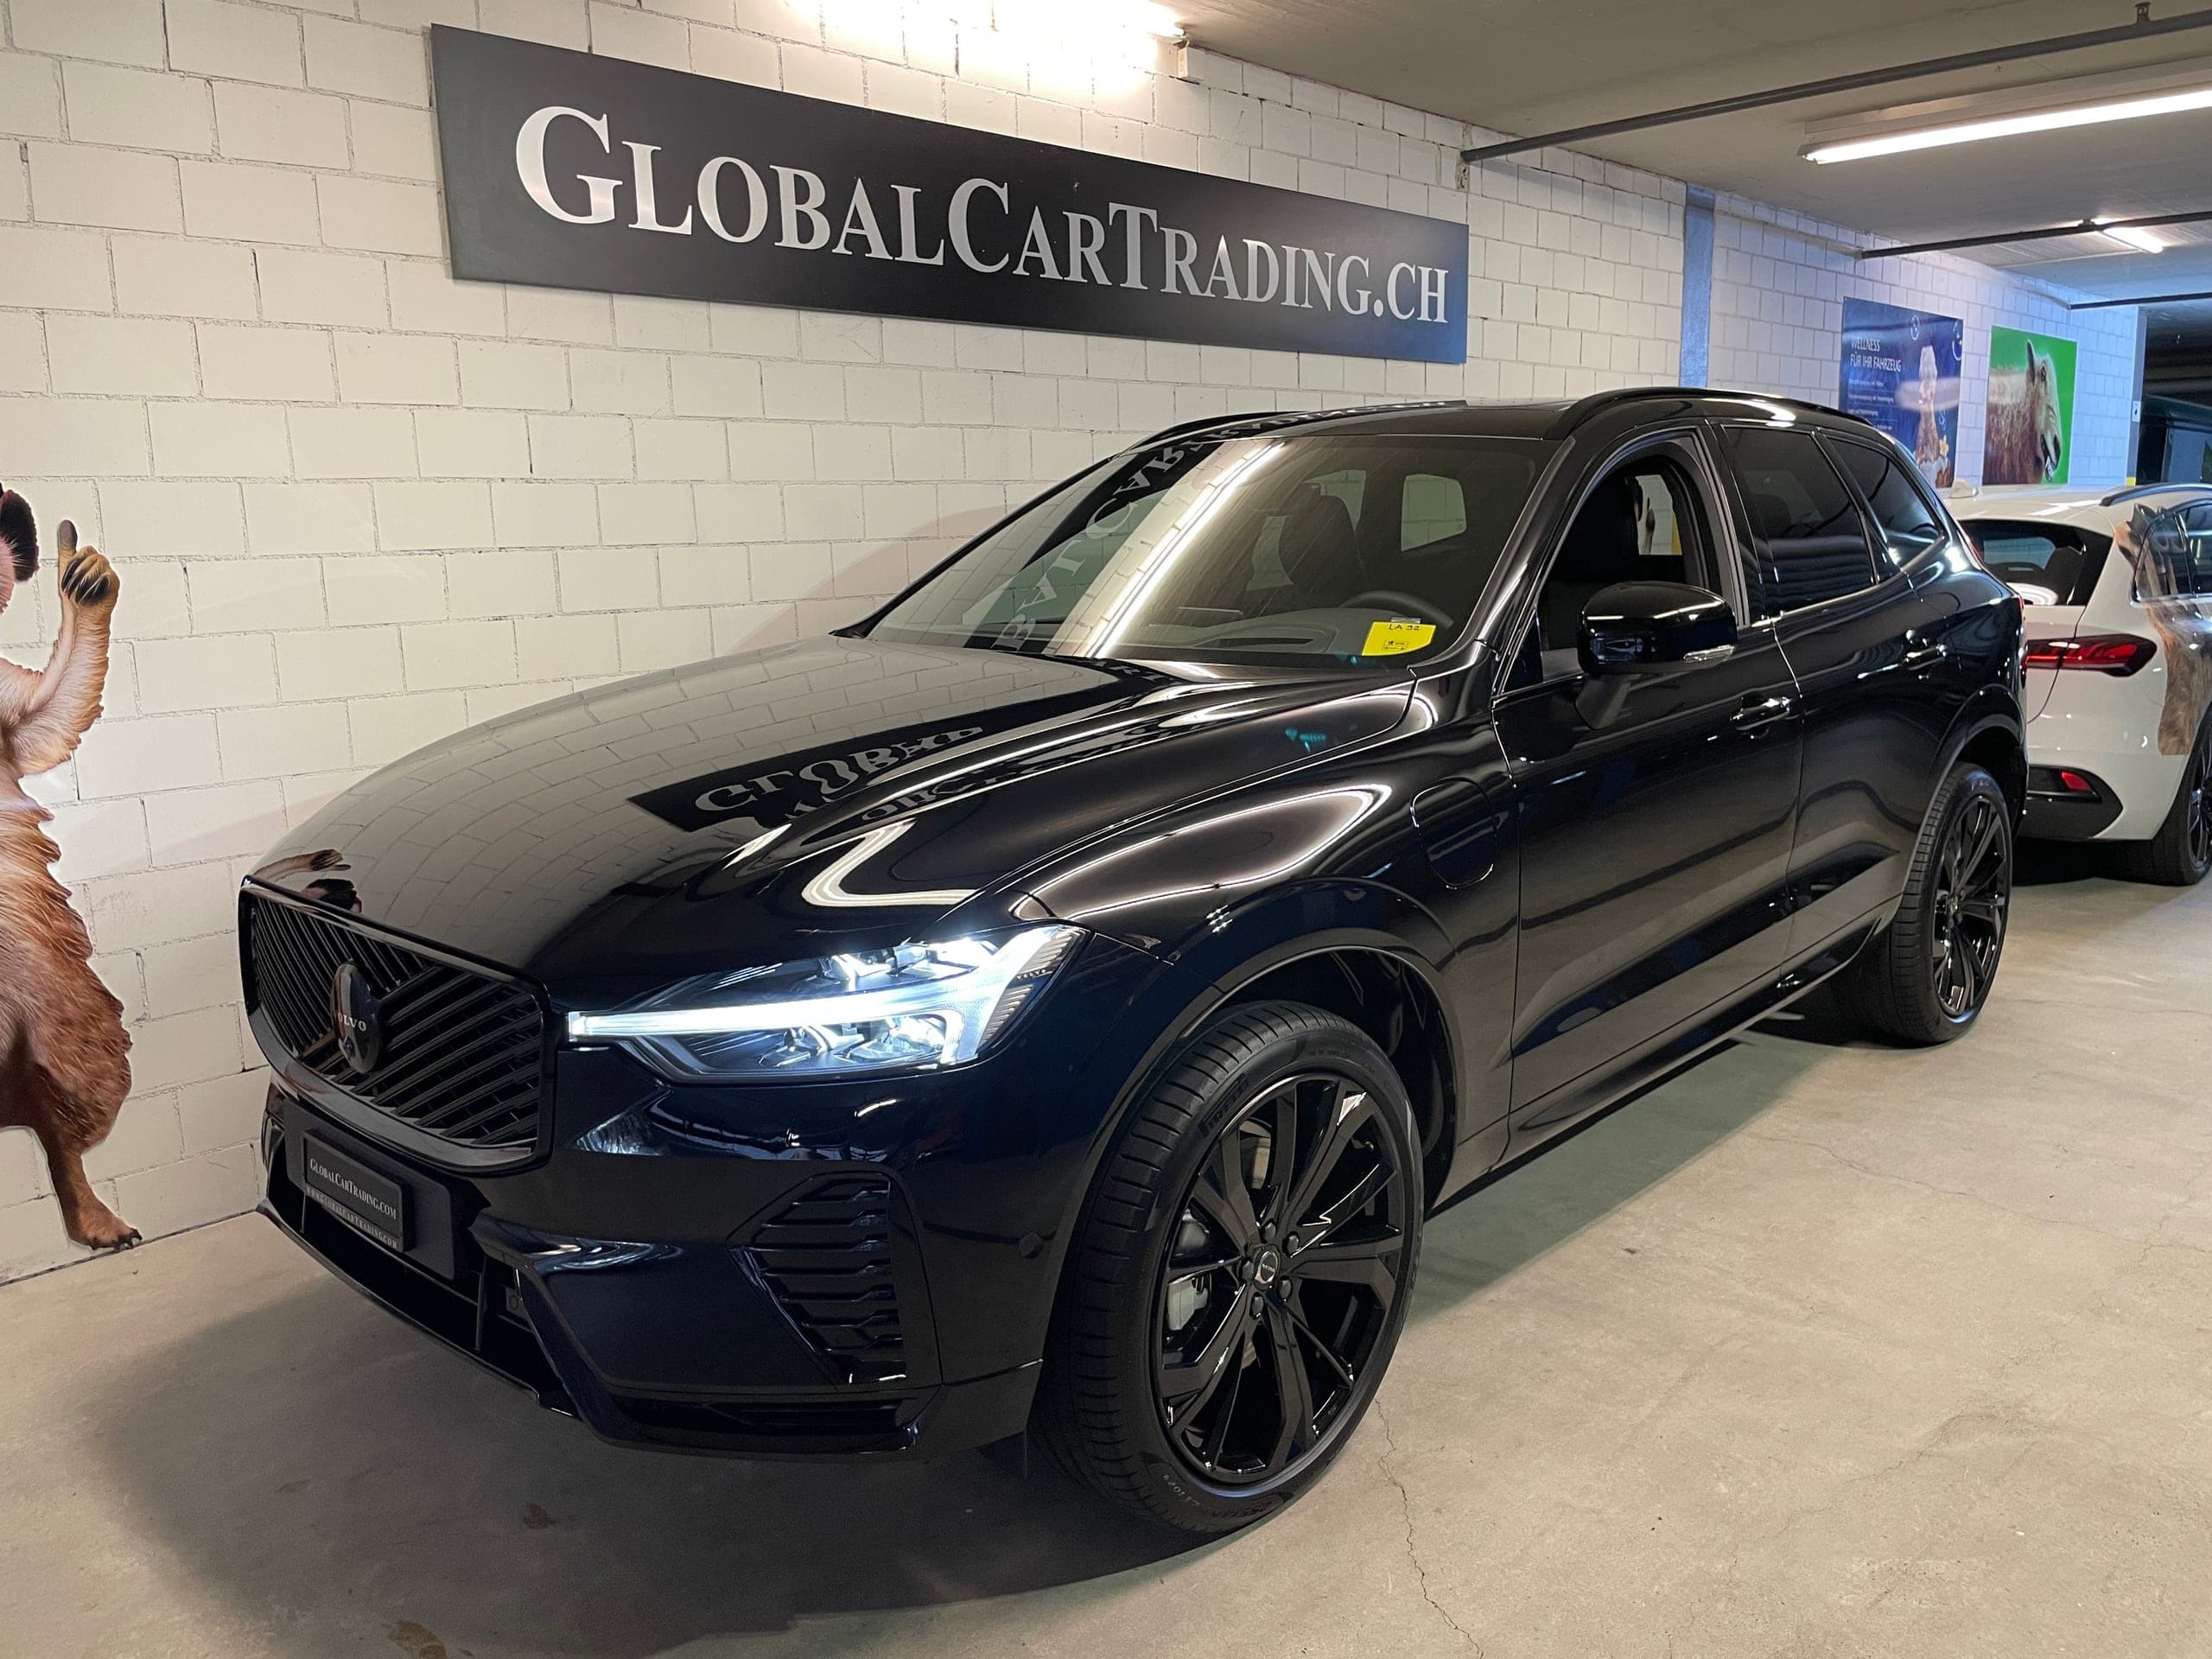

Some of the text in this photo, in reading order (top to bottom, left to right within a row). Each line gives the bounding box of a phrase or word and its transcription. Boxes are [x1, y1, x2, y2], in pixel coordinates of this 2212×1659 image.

[1851, 337, 1880, 352] WELLNESS
[1850, 351, 1902, 372] FÜR IHR FAHRZEUG
[1016, 969, 1046, 980] VOLVO
